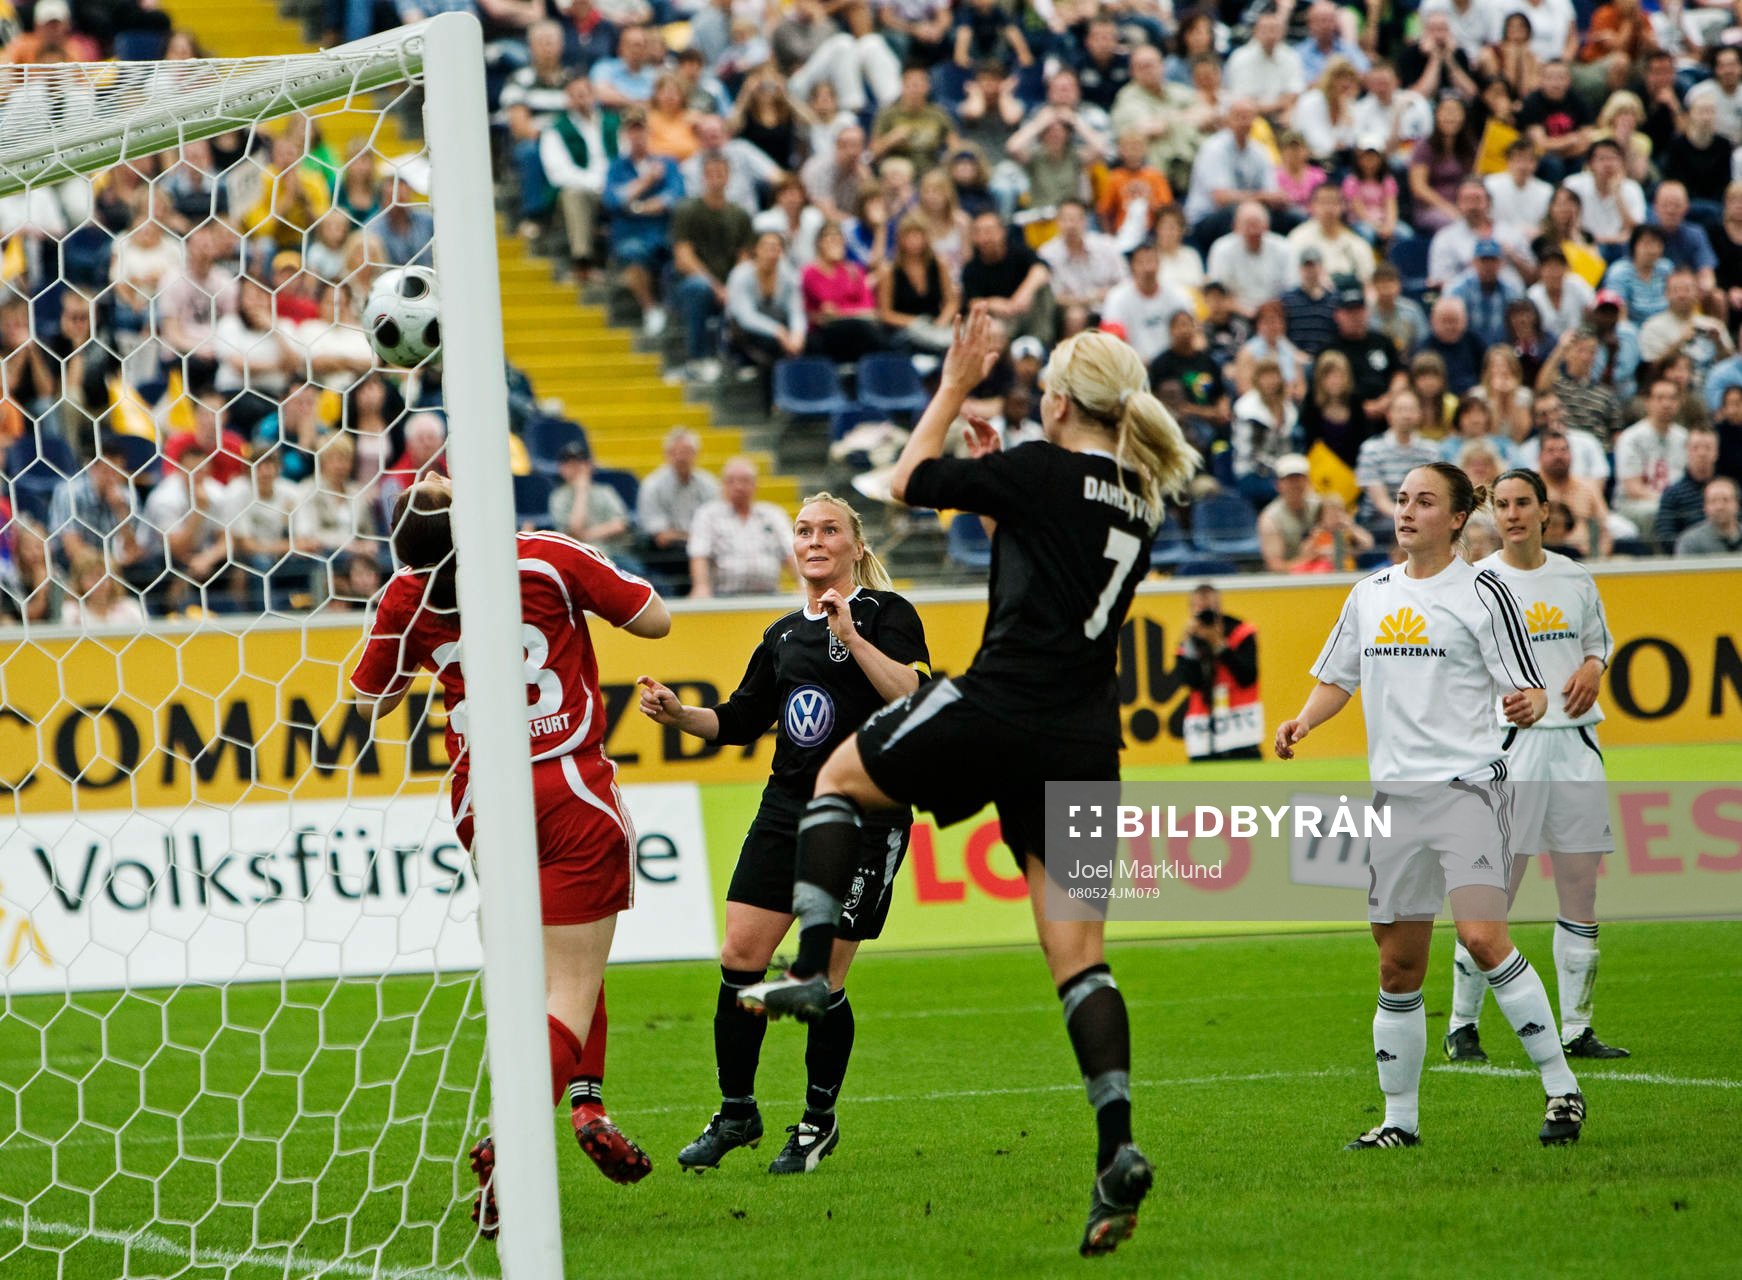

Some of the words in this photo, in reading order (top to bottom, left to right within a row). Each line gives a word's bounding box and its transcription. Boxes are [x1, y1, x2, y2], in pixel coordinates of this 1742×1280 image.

[1084, 526, 1141, 640] 7
[1364, 647, 1447, 658] COMMERZBANK
[528, 713, 570, 737] KFURT
